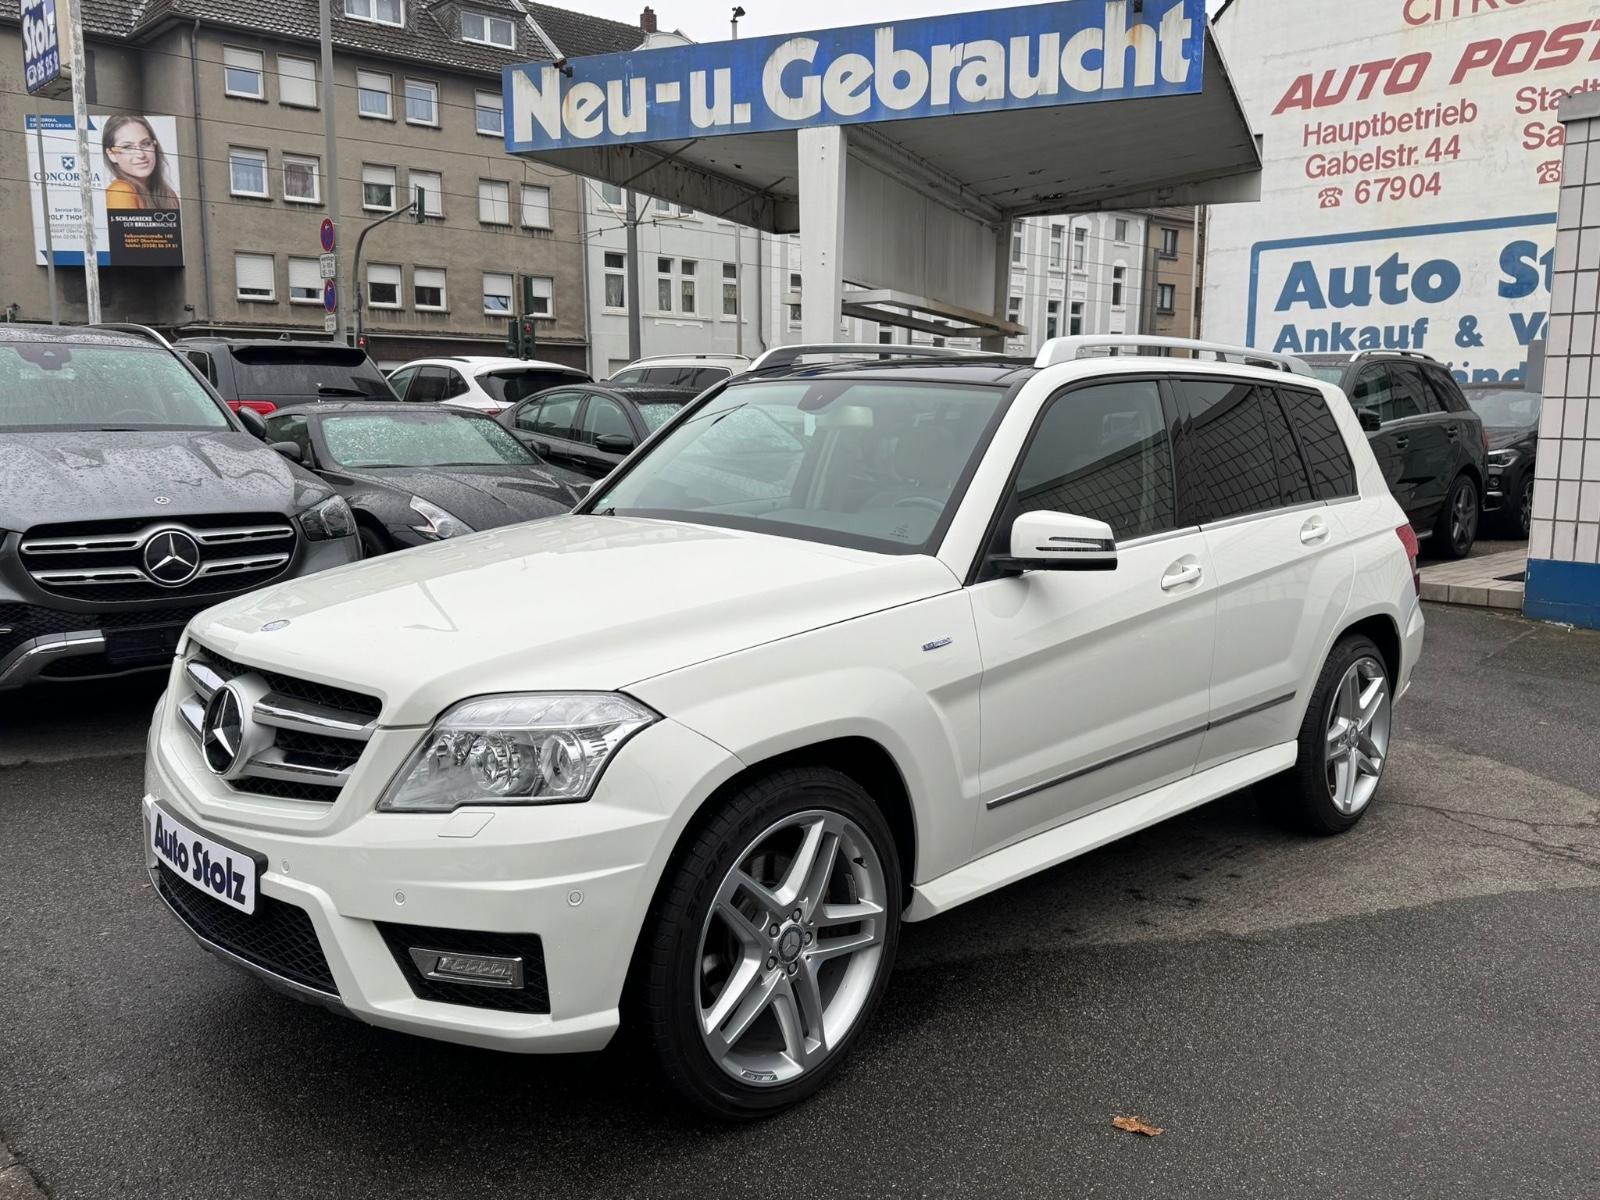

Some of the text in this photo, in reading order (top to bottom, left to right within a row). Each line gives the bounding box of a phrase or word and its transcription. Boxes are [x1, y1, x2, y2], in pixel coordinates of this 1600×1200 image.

[22, 2, 56, 63] Stolz
[762, 0, 1191, 121] Gebraucht
[1271, 52, 1432, 116] AUTO
[1303, 98, 1478, 148] Hauptbetrieb
[1305, 135, 1461, 179] Gabelstr. 44
[1354, 171, 1442, 204] 67904
[1274, 252, 1461, 311] Auto
[1272, 317, 1429, 353] Ankauf
[1455, 314, 1485, 348] &
[154, 813, 246, 905] Auto Stolz
